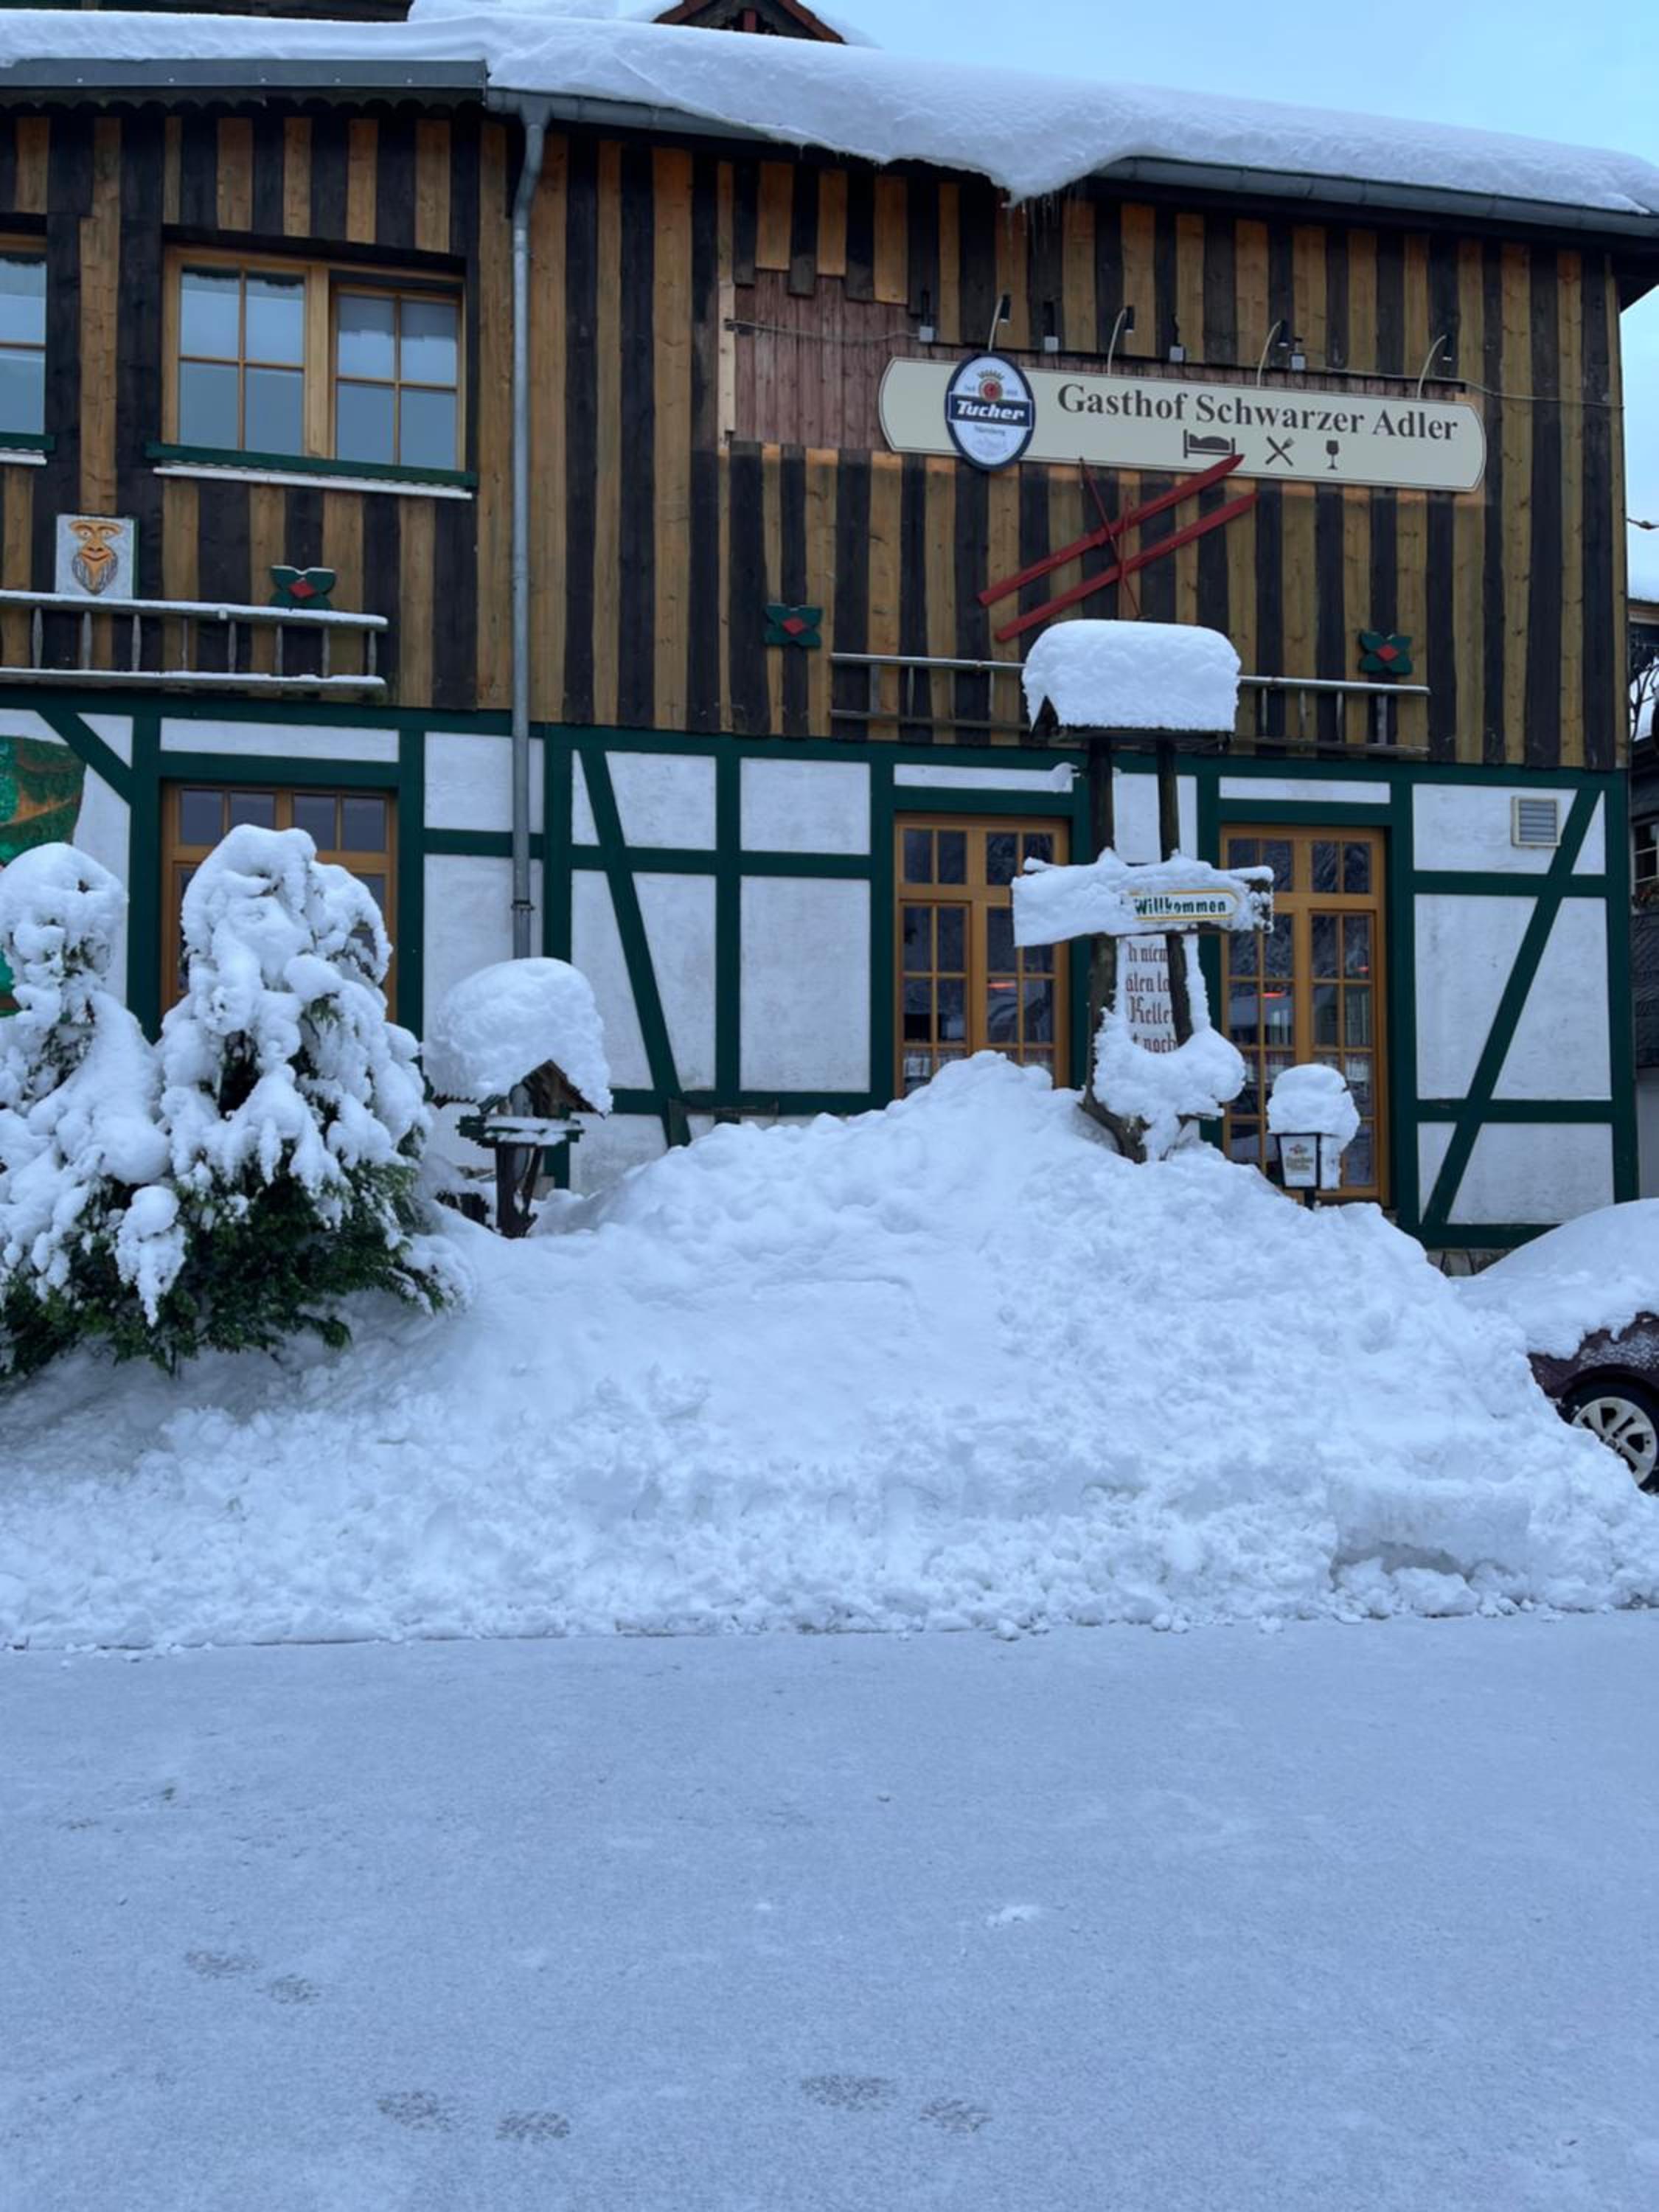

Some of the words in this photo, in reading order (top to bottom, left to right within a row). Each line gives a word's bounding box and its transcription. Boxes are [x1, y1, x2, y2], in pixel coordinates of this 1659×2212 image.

[957, 400, 1025, 420] Tucher
[1057, 383, 1189, 420] Gasthof
[1196, 393, 1365, 434] Schwarzer
[1372, 408, 1458, 441] Adler
[1134, 896, 1226, 915] Willkommen
[1130, 996, 1172, 1024] Kelle
